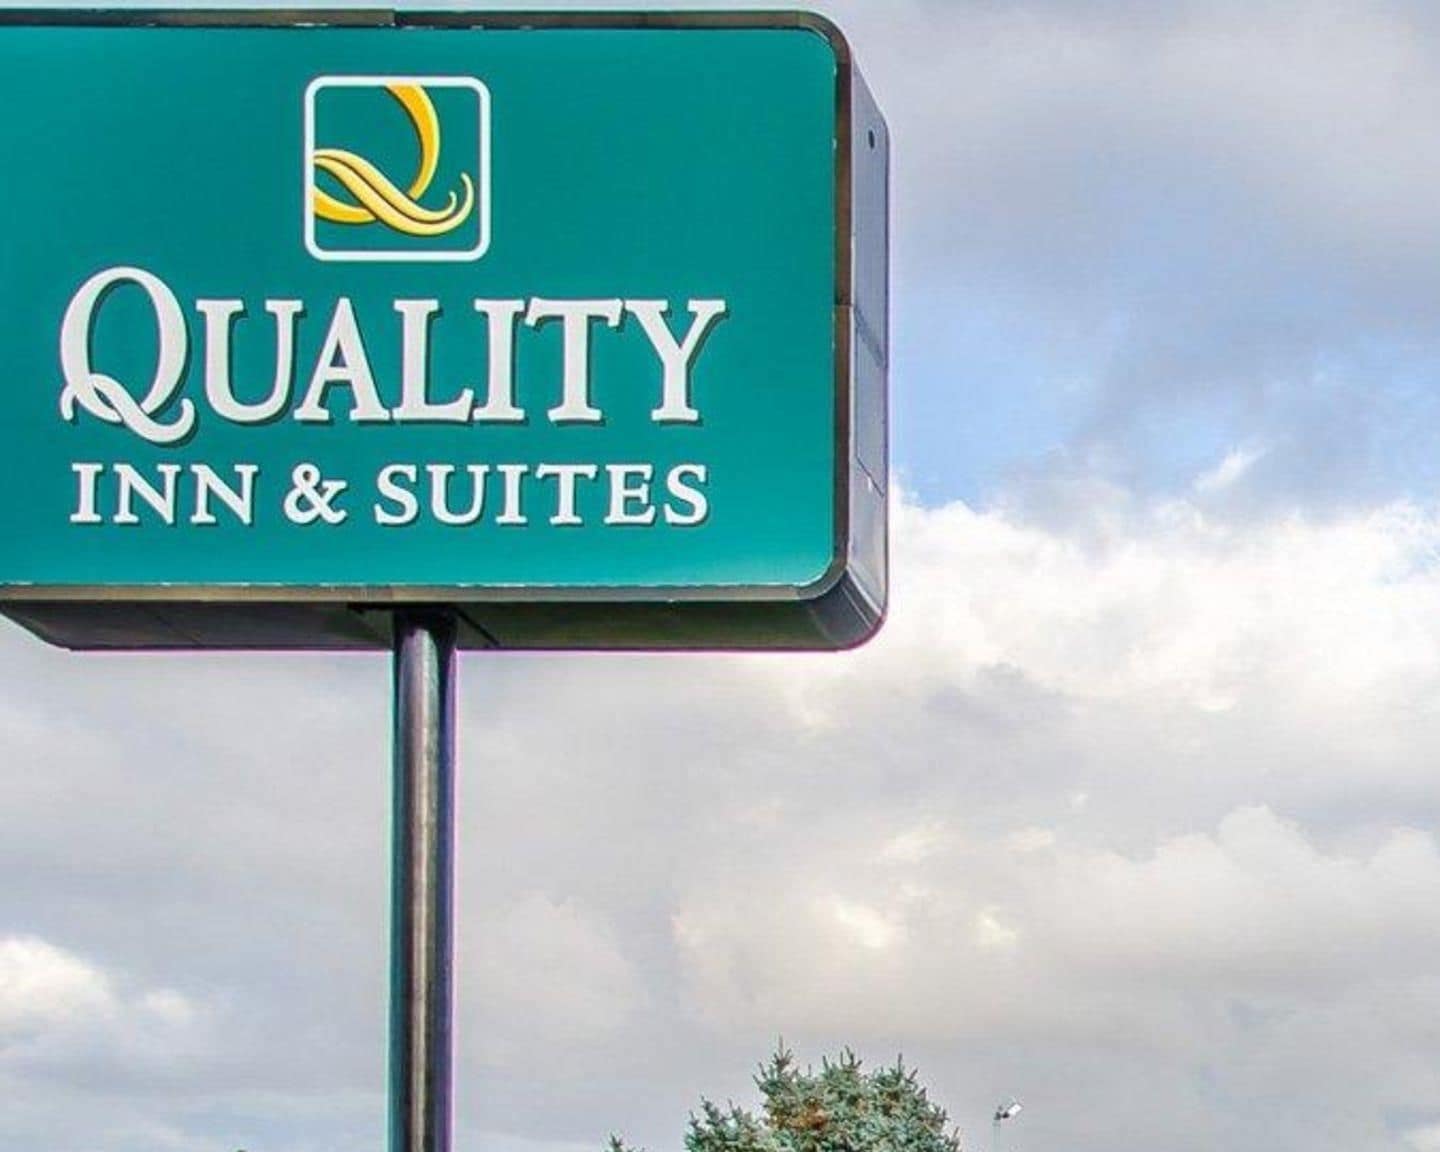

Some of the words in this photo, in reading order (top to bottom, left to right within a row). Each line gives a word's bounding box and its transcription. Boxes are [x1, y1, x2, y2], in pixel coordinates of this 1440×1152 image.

[60, 267, 726, 443] QUALITY
[70, 464, 257, 525] INN
[283, 464, 347, 524] &
[374, 464, 708, 525] SUITES
